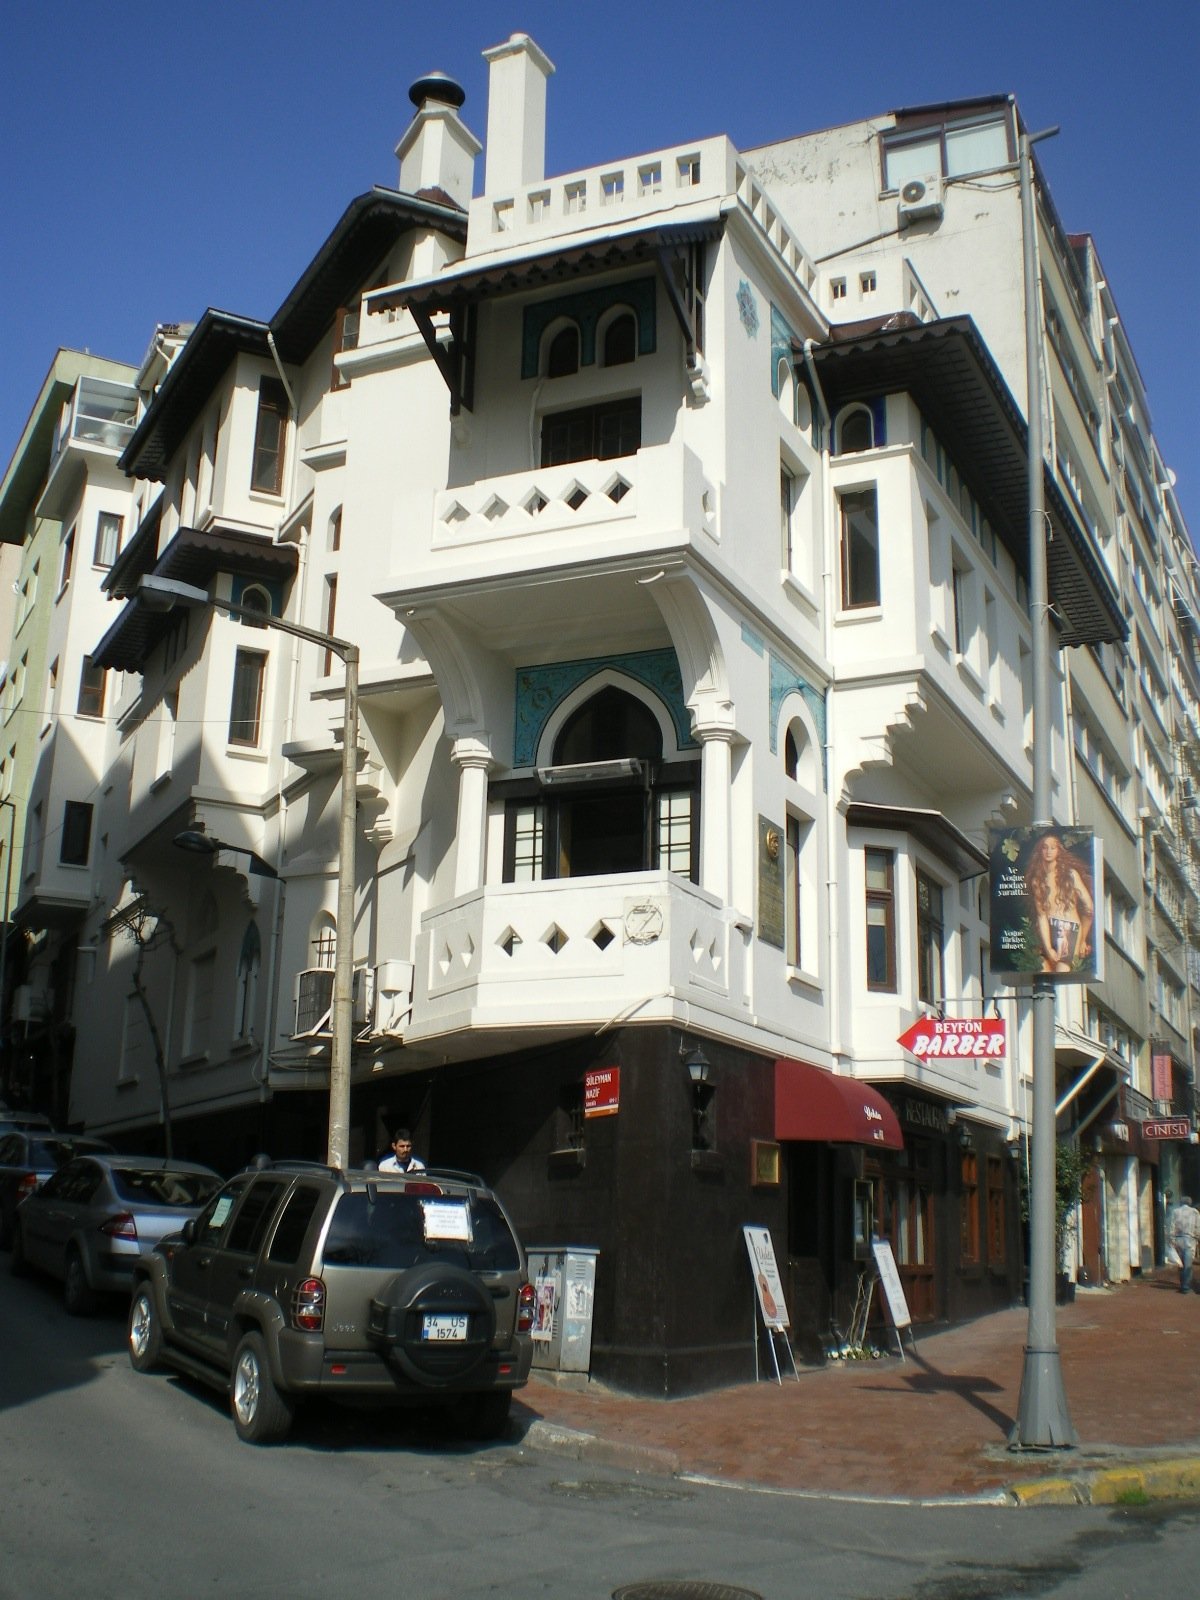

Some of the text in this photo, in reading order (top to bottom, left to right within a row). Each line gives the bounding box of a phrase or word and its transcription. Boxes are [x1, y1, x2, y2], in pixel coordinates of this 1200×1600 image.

[935, 1019, 983, 1034] BEYFÖN
[912, 1033, 1005, 1056] BARBER
[426, 1317, 466, 1327] 34 US
[436, 1328, 458, 1339] 1574
